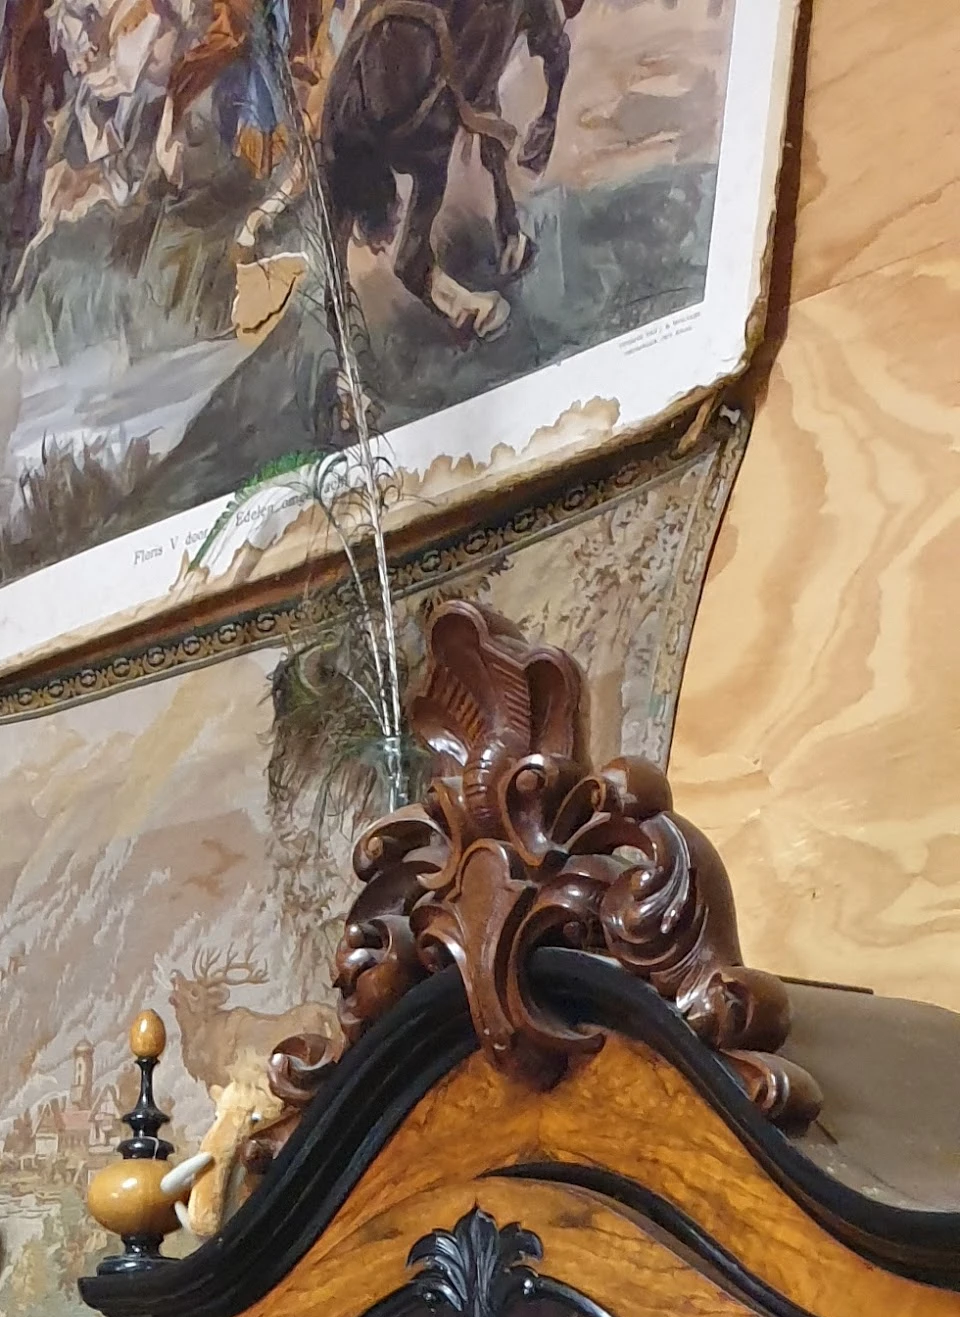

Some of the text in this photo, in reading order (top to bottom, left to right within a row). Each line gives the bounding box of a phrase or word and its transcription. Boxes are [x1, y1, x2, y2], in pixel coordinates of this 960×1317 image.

[134, 546, 164, 565] Floris
[170, 535, 179, 550] V
[185, 529, 208, 546] door
[235, 502, 274, 527] Edelen
